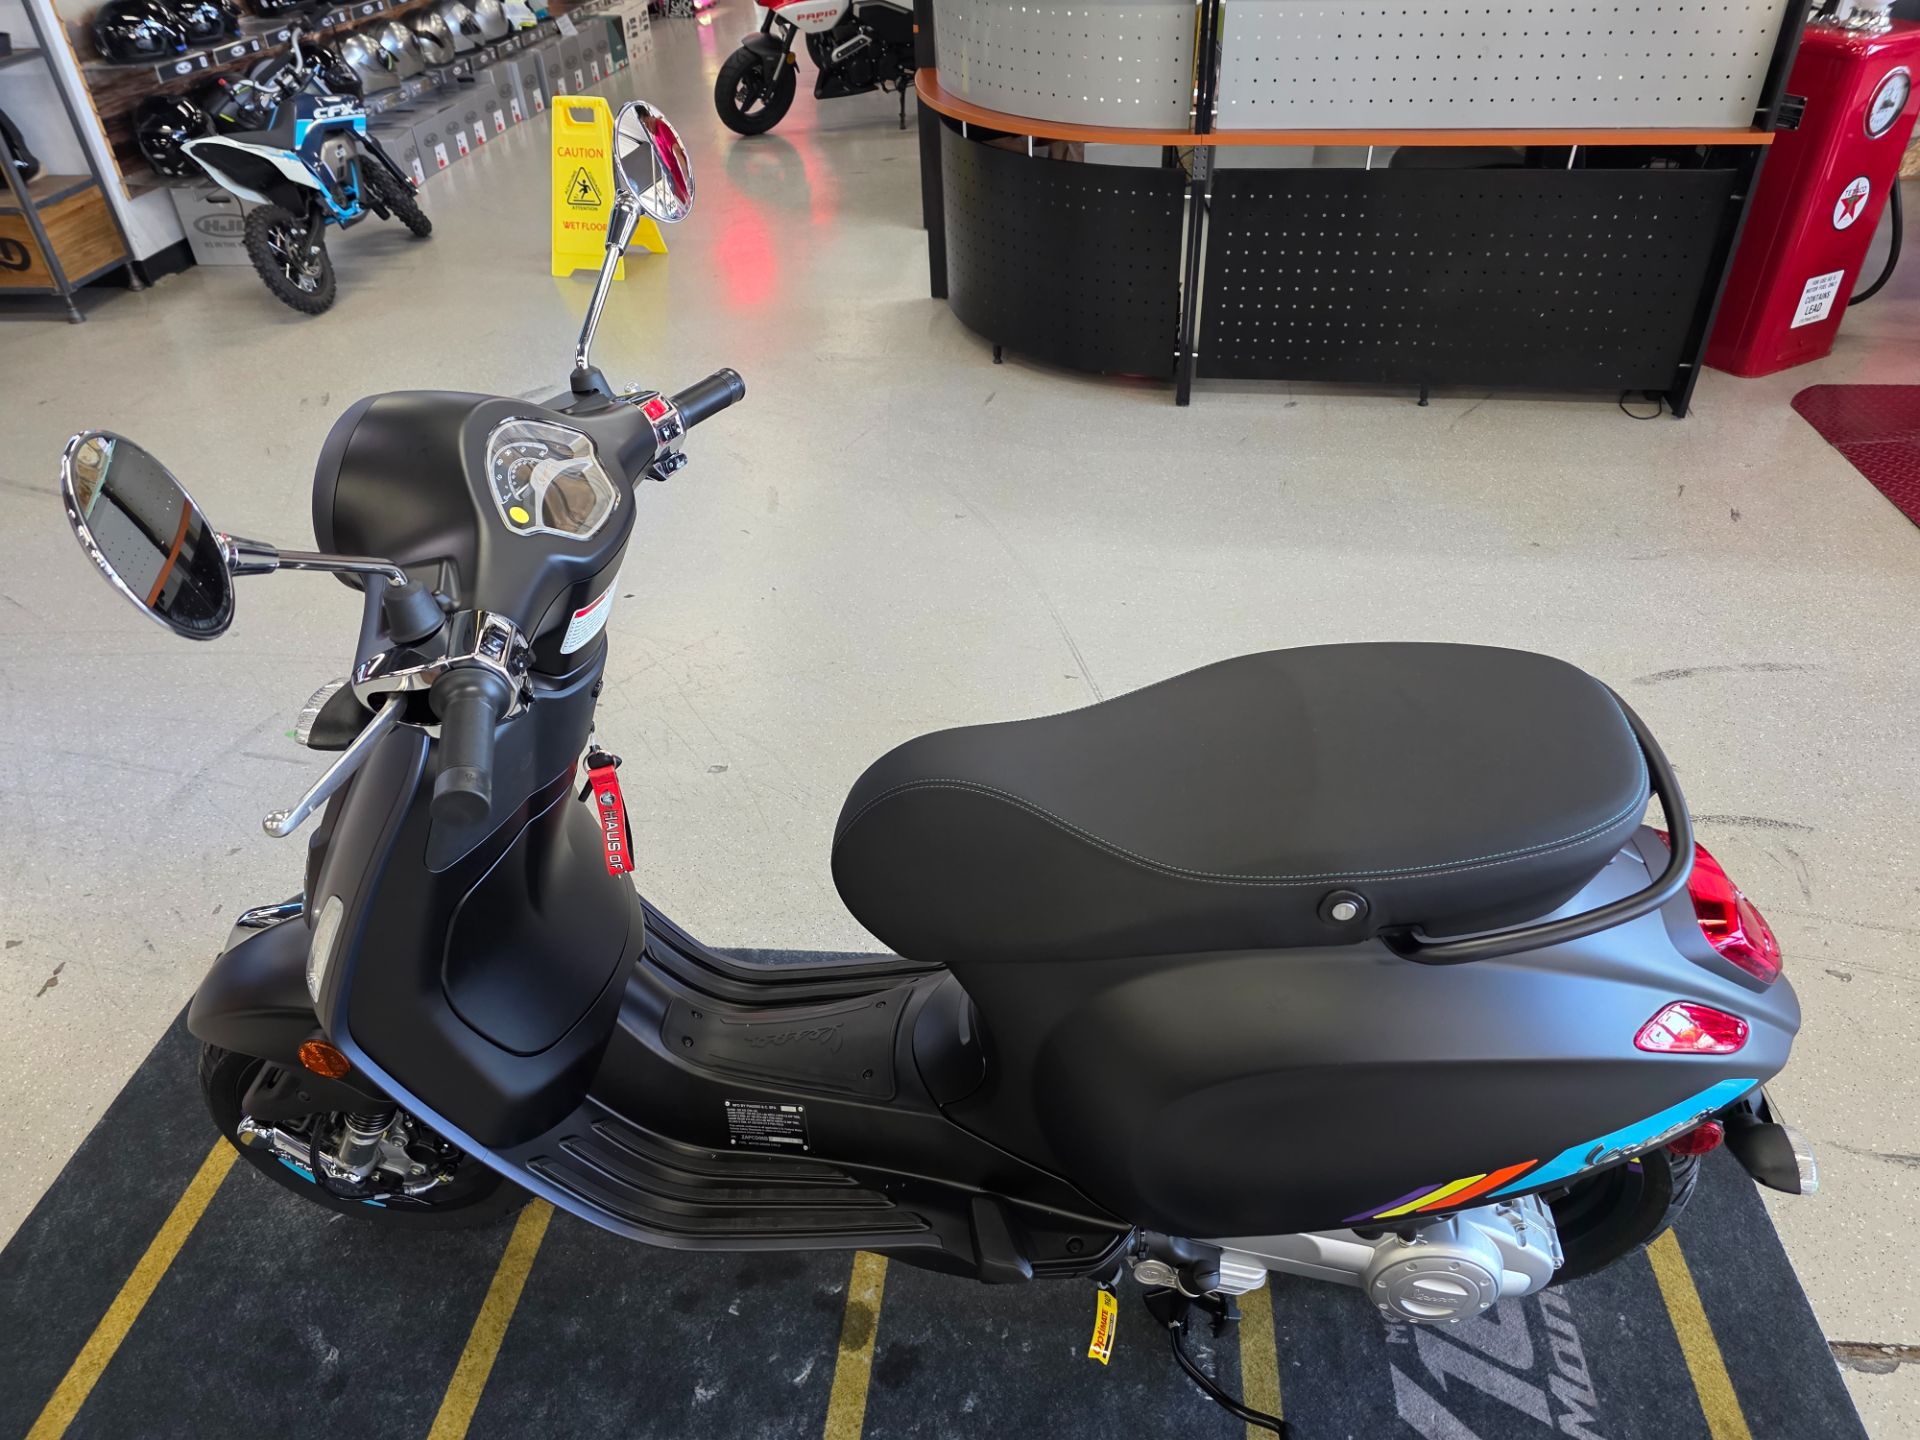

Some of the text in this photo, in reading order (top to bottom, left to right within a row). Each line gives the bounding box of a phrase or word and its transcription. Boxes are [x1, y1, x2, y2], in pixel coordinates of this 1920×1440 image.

[796, 9, 838, 21] PAPIO
[557, 146, 604, 159] CAUTION
[563, 221, 580, 230] WET
[1804, 290, 1831, 304] CONTAINS
[1804, 302, 1823, 316] LEAD
[603, 810, 621, 852] HAUS
